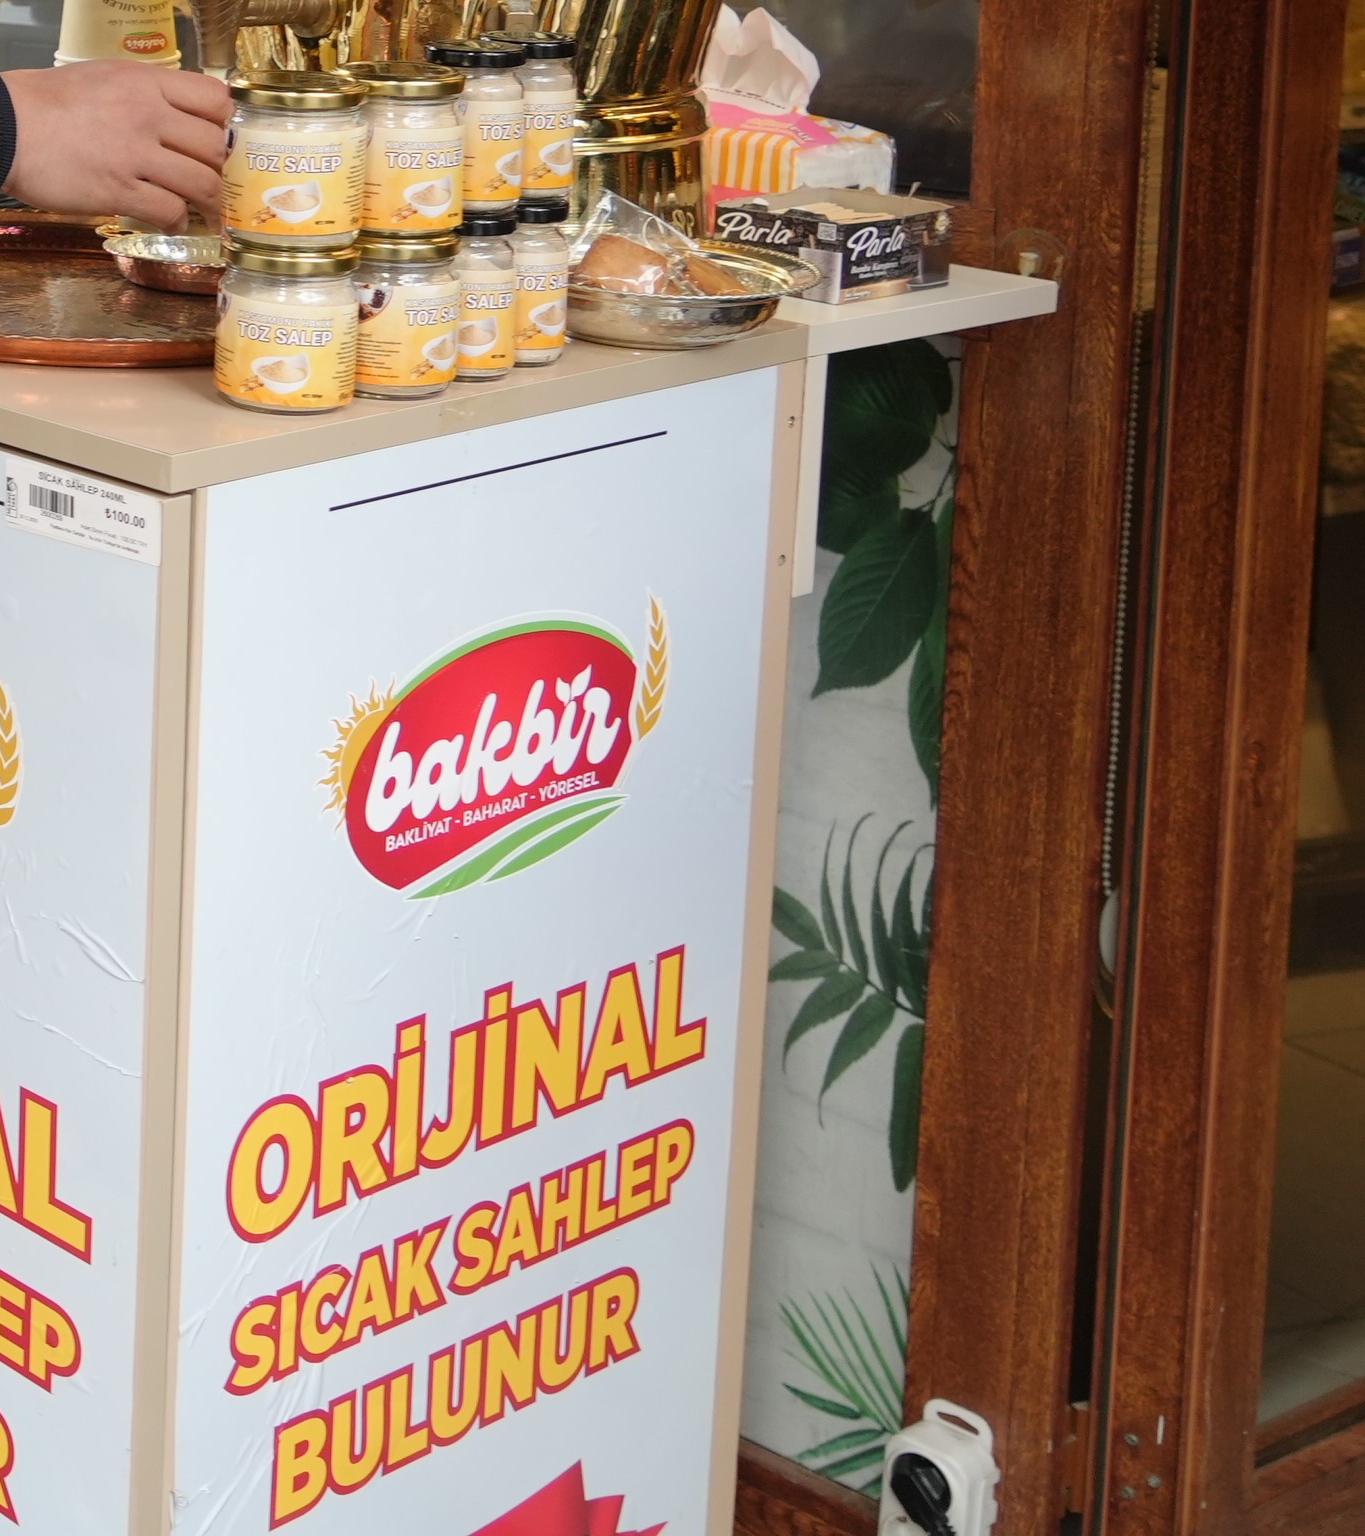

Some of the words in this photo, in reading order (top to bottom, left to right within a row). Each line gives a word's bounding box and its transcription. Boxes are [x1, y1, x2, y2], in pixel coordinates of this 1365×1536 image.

[479, 124, 512, 141] TOZ
[524, 113, 557, 130] TOZ
[246, 153, 281, 173] TOZ
[284, 155, 343, 174] SALEP
[385, 151, 424, 169] TOZ
[716, 211, 795, 246] Parla
[846, 224, 907, 262] Parla
[515, 275, 547, 292] TOZ
[465, 292, 514, 311] SALEP
[404, 308, 438, 327] TOZ
[237, 320, 272, 343] TOZ
[274, 327, 333, 348] SALEP
[65, 477, 99, 496] SAHLEP
[364, 663, 623, 833] bakbir
[384, 815, 453, 853] BAKLİYAT
[462, 793, 528, 828] BAHARAT
[538, 771, 600, 803] YÖRESEL
[226, 944, 707, 1244] ORİJİNAL
[223, 1215, 453, 1396] SICAK
[447, 1119, 695, 1295] SAHLEP
[269, 1266, 641, 1532] BULUNUR
